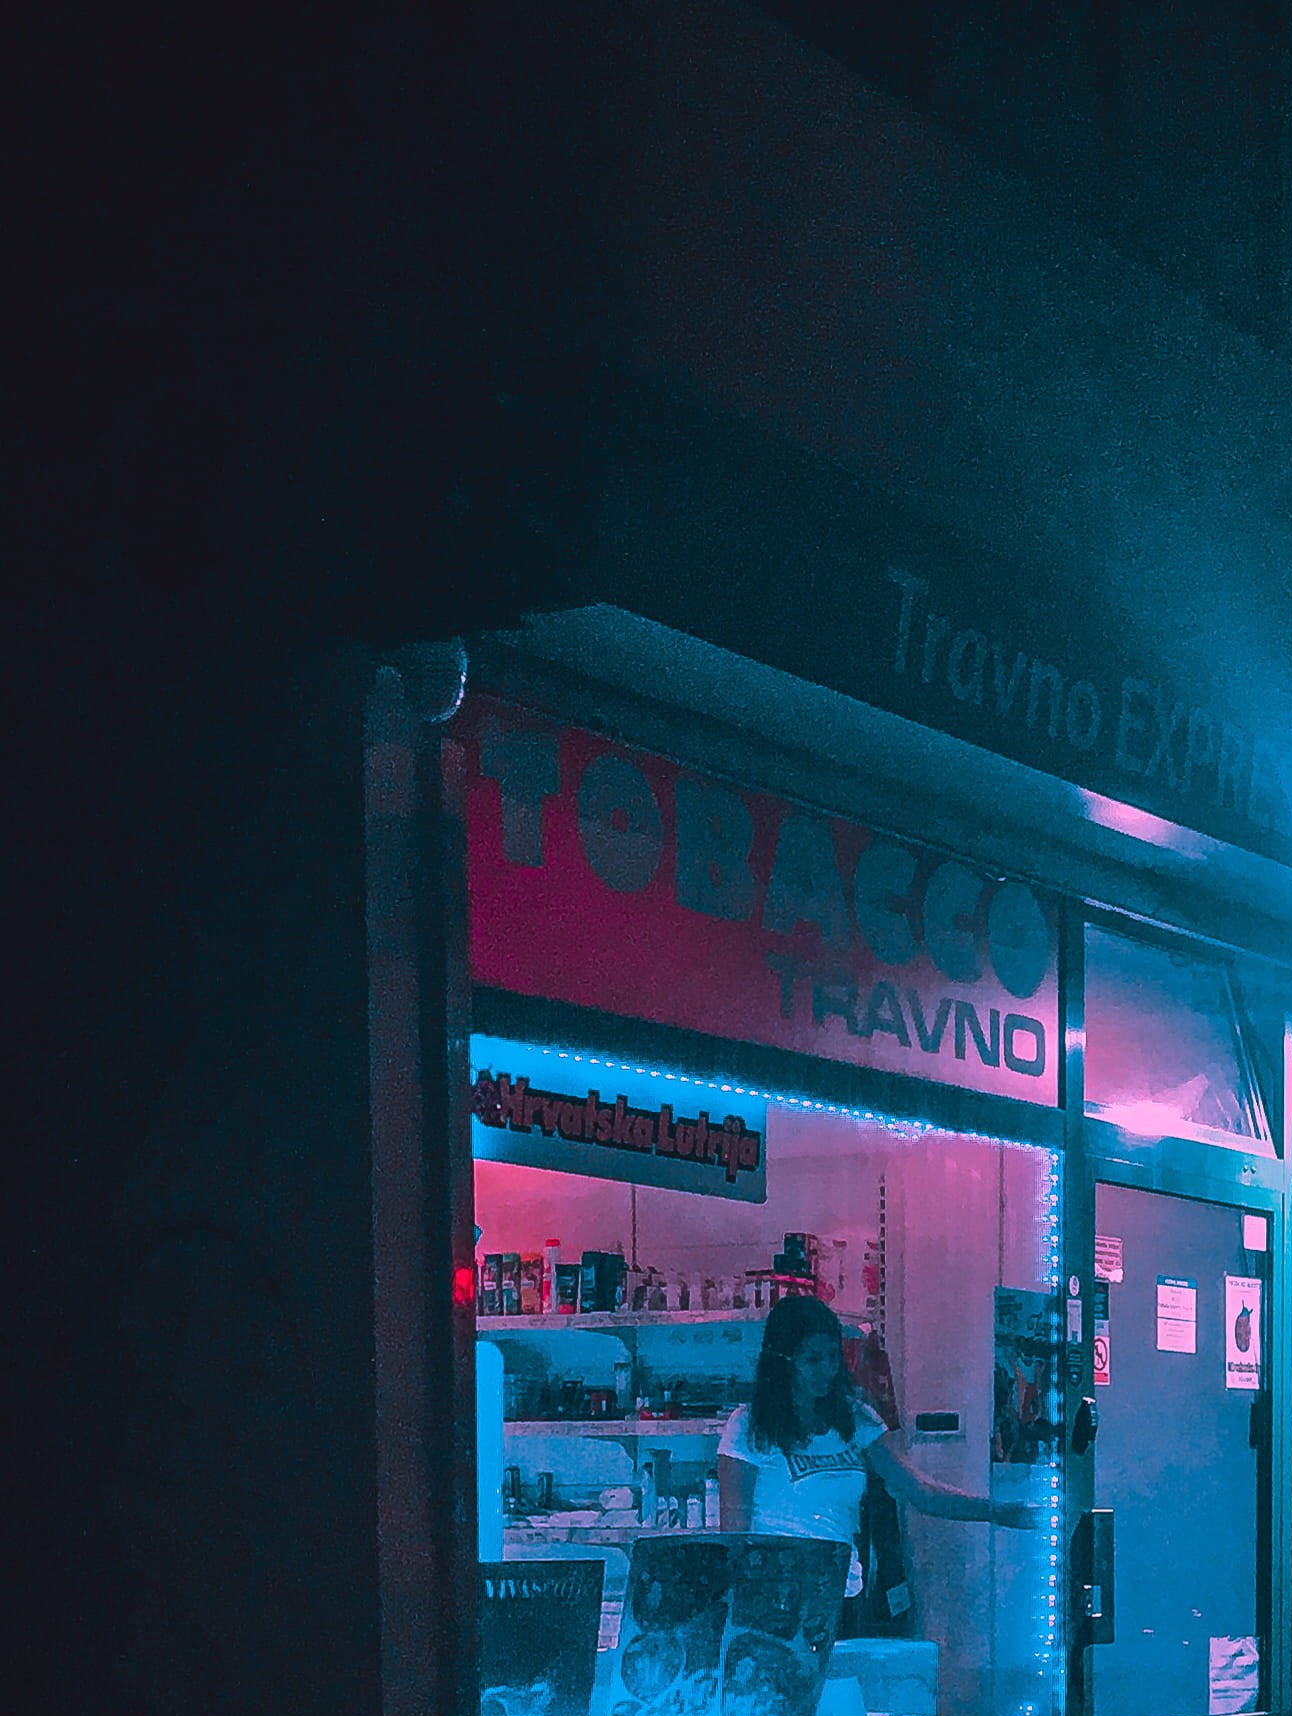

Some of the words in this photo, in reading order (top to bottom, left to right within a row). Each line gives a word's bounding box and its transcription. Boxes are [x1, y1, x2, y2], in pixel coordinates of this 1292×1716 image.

[886, 563, 1102, 750] Travno
[480, 722, 1053, 998] TOBACCO
[764, 950, 1046, 1078] TRAVNO
[498, 1073, 655, 1152] Hrvatska
